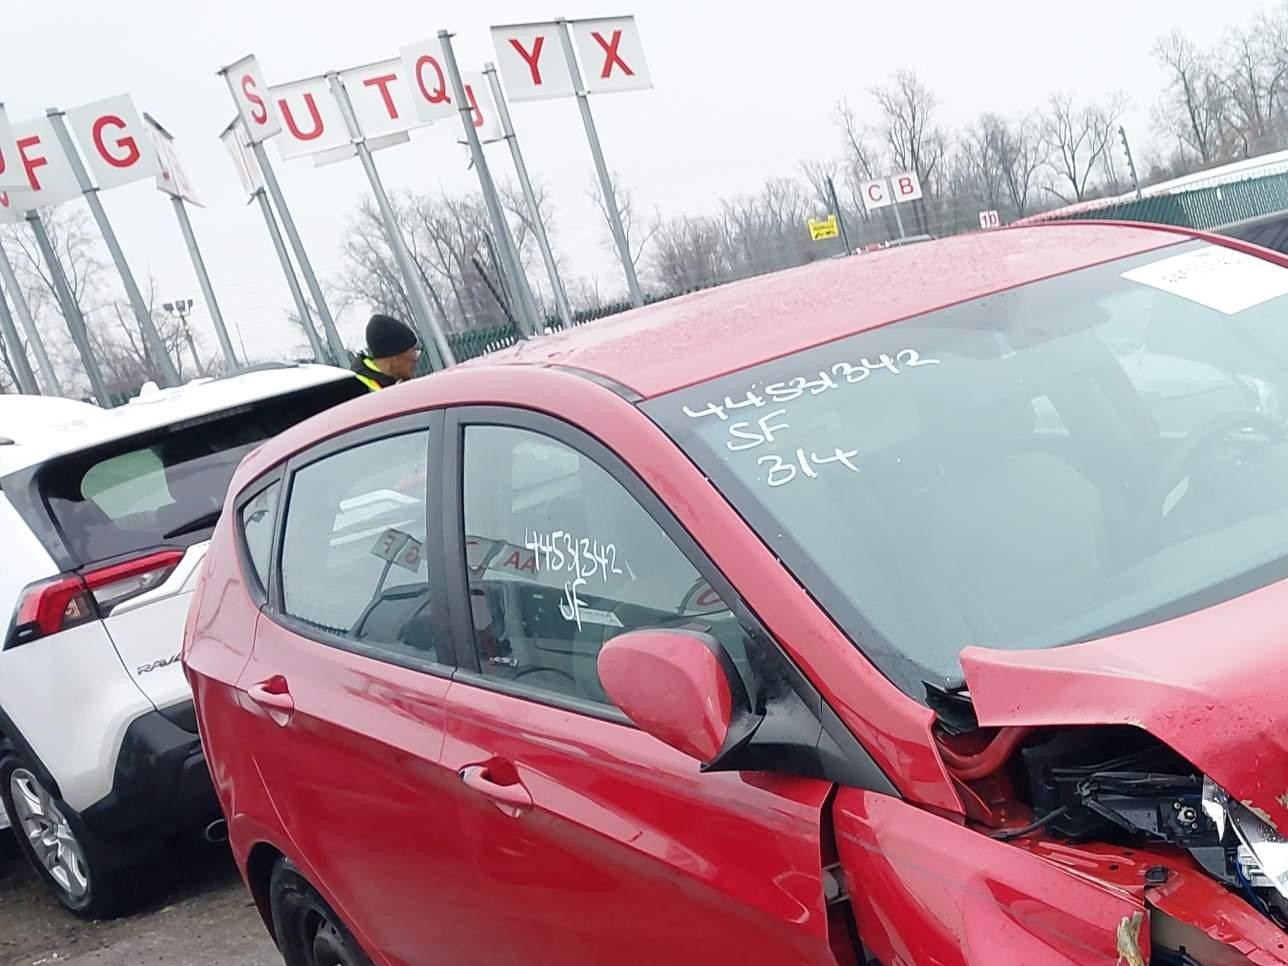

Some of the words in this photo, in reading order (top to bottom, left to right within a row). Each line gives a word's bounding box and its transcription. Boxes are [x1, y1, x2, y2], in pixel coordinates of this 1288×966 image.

[416, 55, 450, 104] Q
[509, 36, 545, 86] Y
[591, 30, 634, 78] X
[241, 75, 267, 125] S
[278, 93, 324, 141] U
[363, 74, 398, 119] T
[16, 135, 48, 191] F
[92, 115, 141, 168] G
[868, 184, 883, 201] C
[898, 177, 914, 196] B
